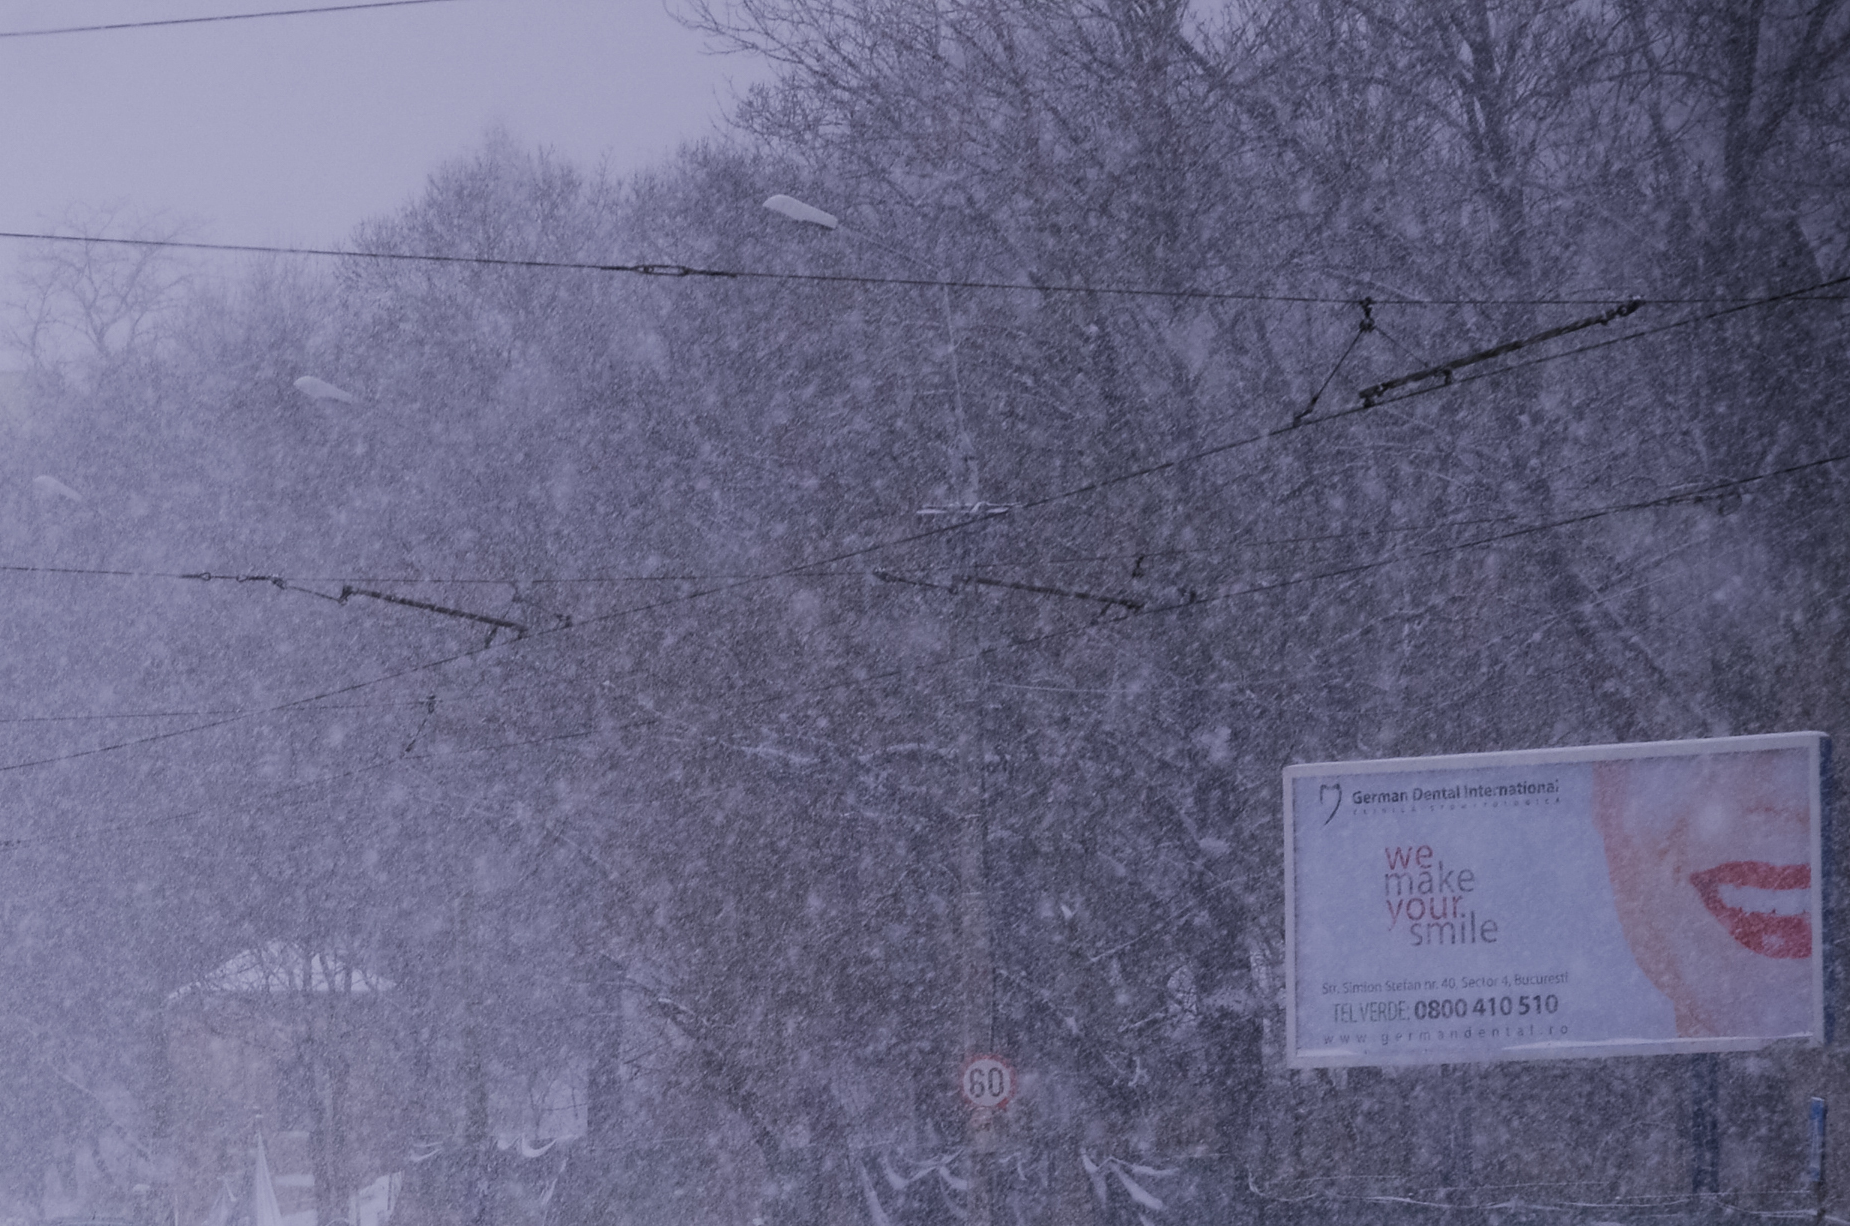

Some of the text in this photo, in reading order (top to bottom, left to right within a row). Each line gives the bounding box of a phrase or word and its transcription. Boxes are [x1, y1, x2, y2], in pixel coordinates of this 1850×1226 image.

[1352, 778, 1560, 805] German Dental International
[1385, 845, 1433, 870] we
[1385, 861, 1475, 896] make
[1386, 895, 1463, 931] your
[1410, 910, 1498, 946] smile
[1342, 980, 1382, 994] Simion
[1461, 976, 1498, 989] Sector
[1333, 1003, 1357, 1023] TEL
[1414, 998, 1468, 1020] 0800
[1472, 995, 1513, 1016] 410
[1518, 994, 1559, 1015] 510
[970, 1067, 1004, 1098] 60
